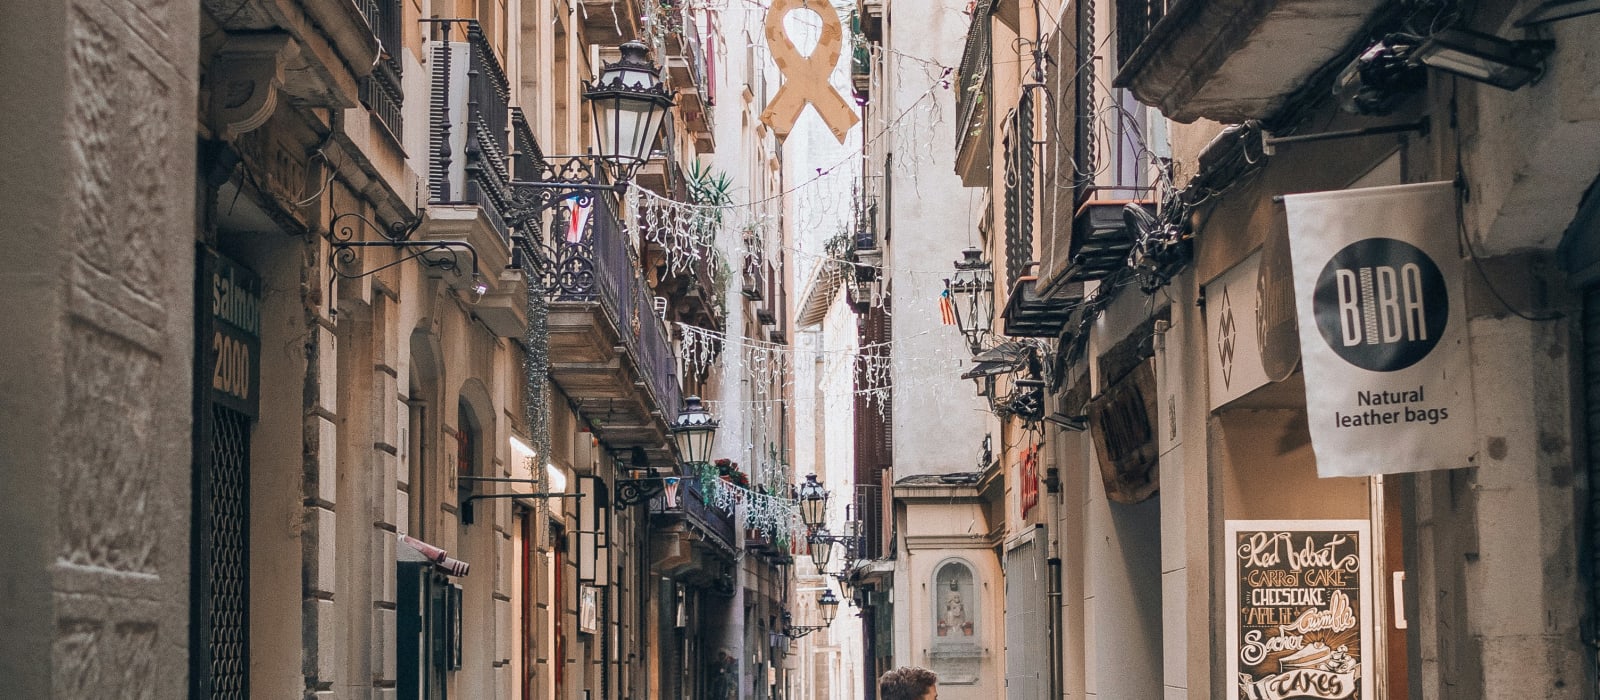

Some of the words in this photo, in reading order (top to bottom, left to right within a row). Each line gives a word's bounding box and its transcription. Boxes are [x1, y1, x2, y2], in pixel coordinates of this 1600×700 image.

[1336, 262, 1427, 347] BIBA
[213, 331, 250, 400] 2000
[1357, 385, 1424, 406] Natural
[1335, 408, 1400, 428] leather
[1404, 406, 1449, 425] bags
[1238, 532, 1283, 568] Red
[1304, 569, 1346, 587] CAKE
[1252, 587, 1326, 606] CHEESECAKE
